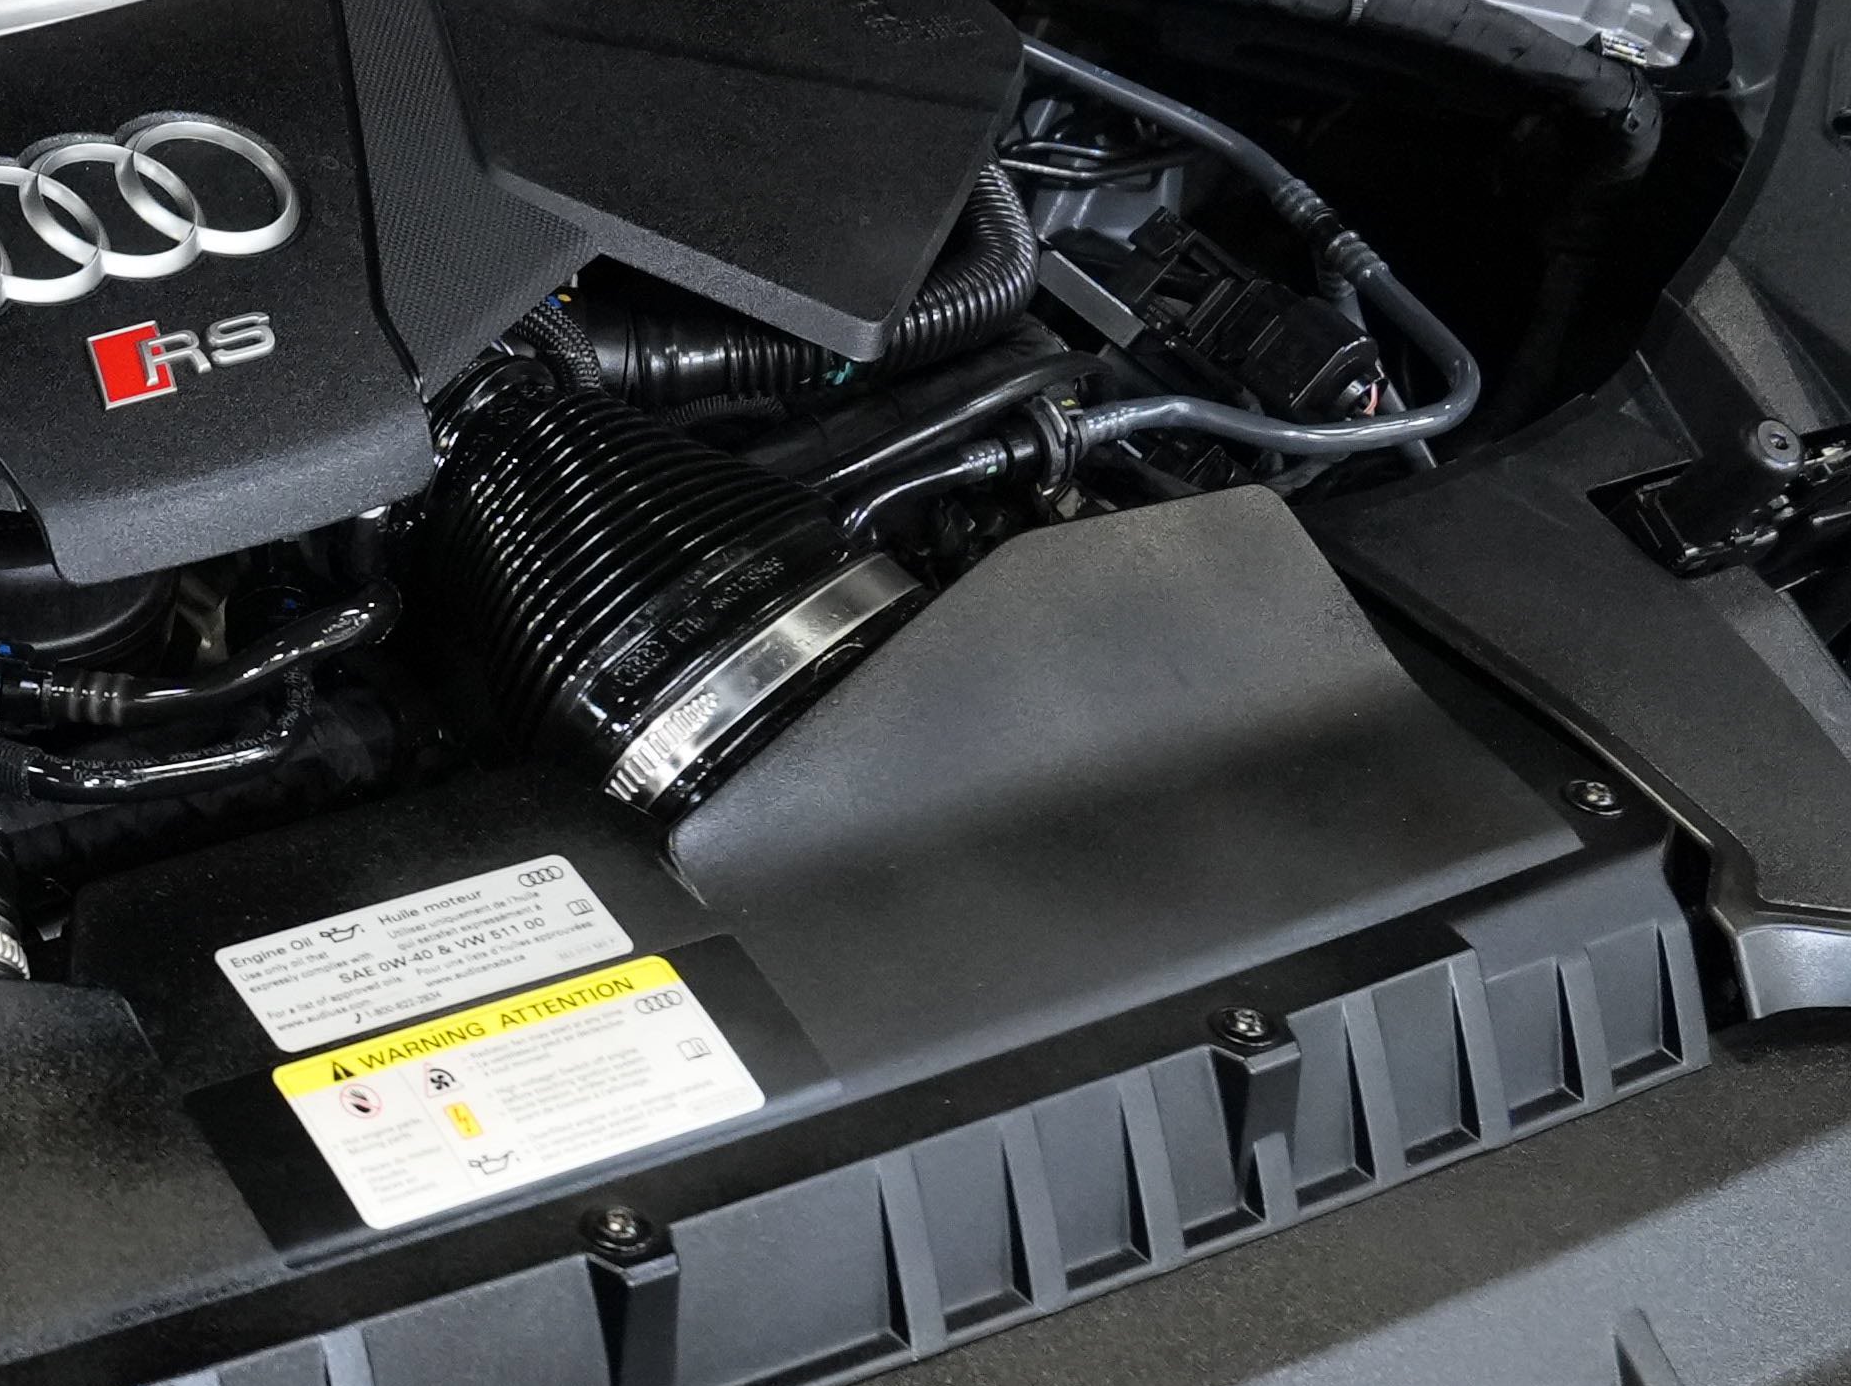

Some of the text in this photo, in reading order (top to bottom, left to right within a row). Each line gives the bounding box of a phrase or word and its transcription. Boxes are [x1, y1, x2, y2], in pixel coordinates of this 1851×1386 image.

[142, 312, 275, 386] RS
[378, 890, 482, 926] Huile moteur
[388, 922, 427, 940] Utilisez
[428, 905, 491, 930] uniquement
[230, 937, 313, 968] Engine Oil
[339, 916, 546, 984] SAE 0W-40 & VW 511 00
[398, 939, 415, 952] qui
[417, 924, 460, 946] satisfait
[239, 950, 329, 983] Use only oil that
[249, 951, 373, 994] expressly complies with
[415, 963, 443, 977] Pour
[467, 950, 490, 966] liste
[315, 995, 328, 1006] of
[330, 984, 382, 1005] approved
[358, 1022, 487, 1070] WARNING
[499, 976, 636, 1029] ATTENTION
